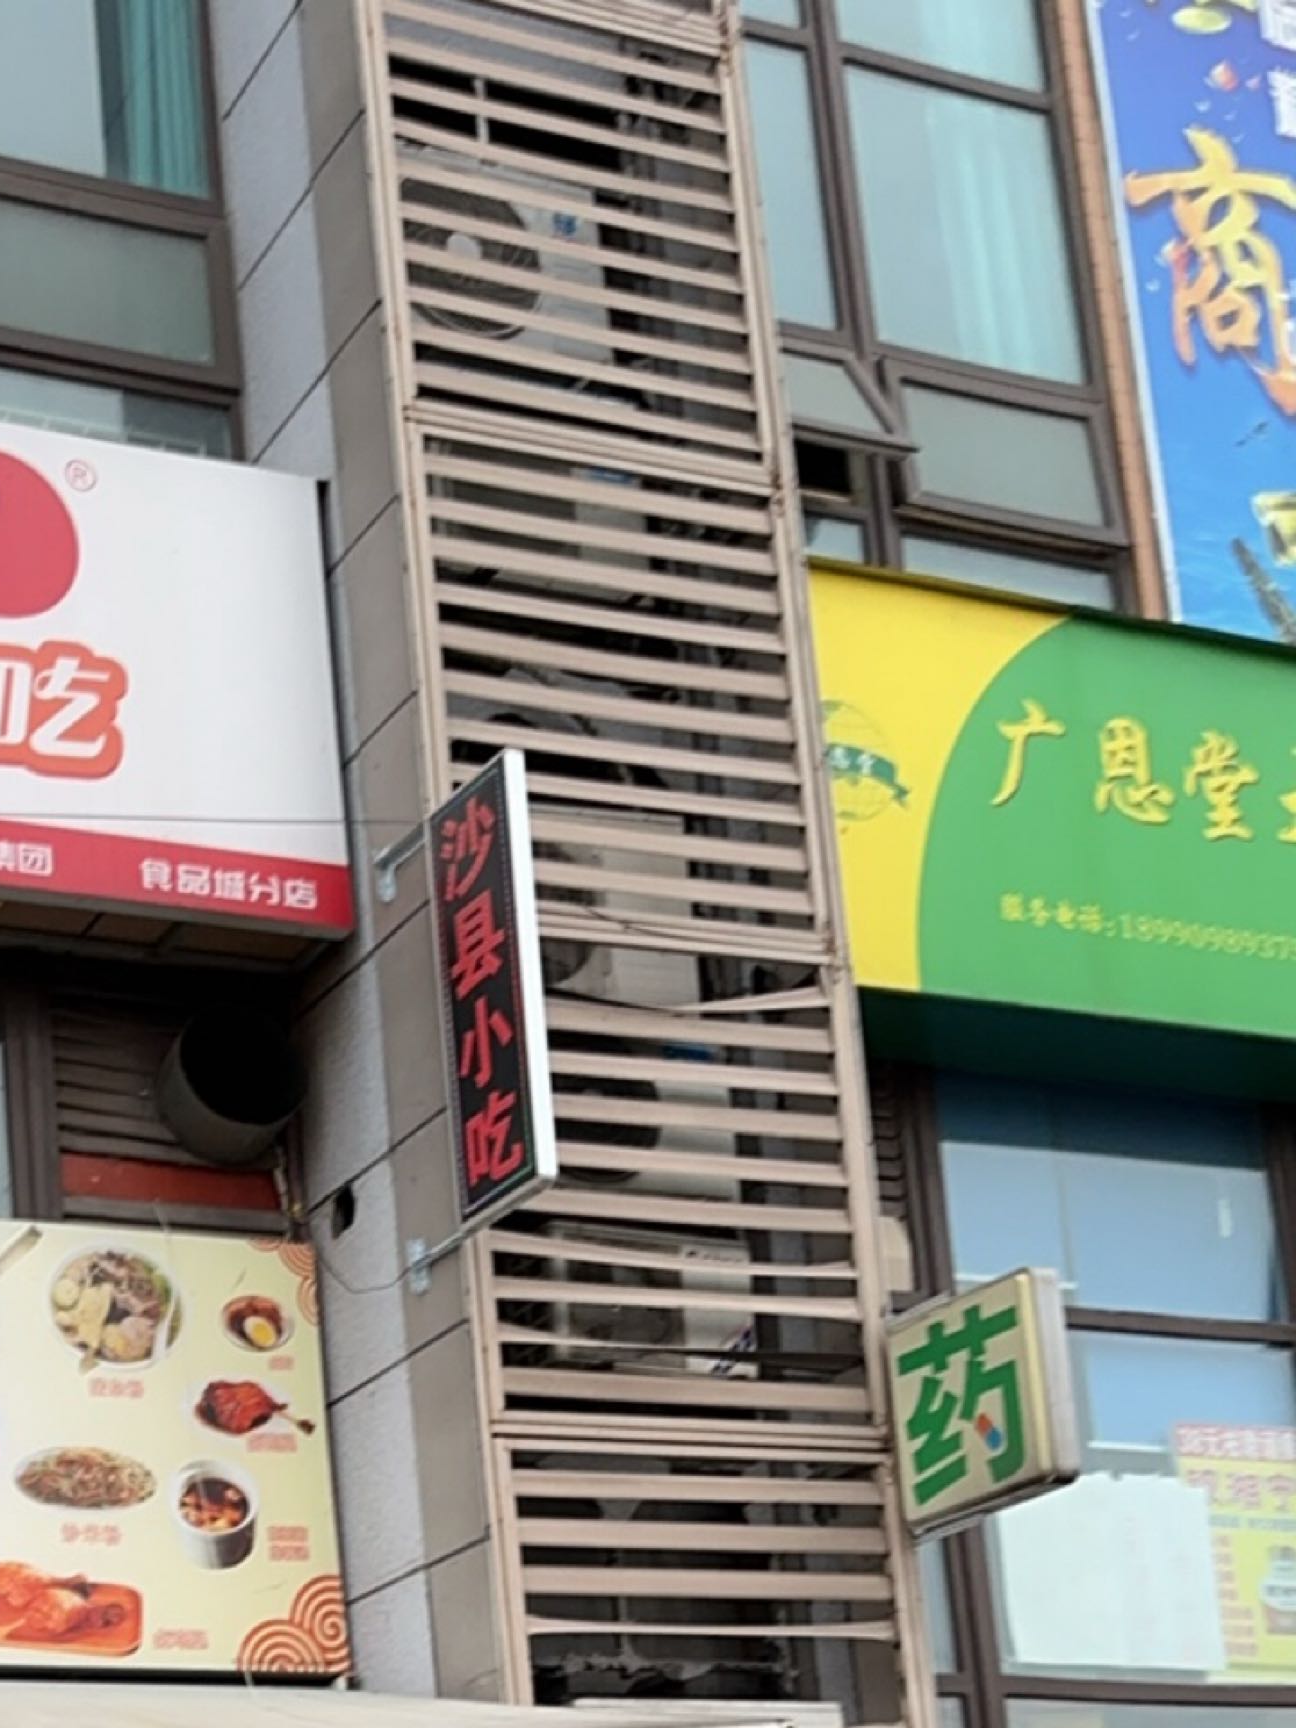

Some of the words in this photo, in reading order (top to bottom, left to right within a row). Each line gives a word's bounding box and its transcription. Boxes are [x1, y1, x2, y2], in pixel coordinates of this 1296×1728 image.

[139, 857, 318, 911] 食品城分店
[439, 796, 524, 1186] 沙县小吃
[897, 1304, 1026, 1506] 药
